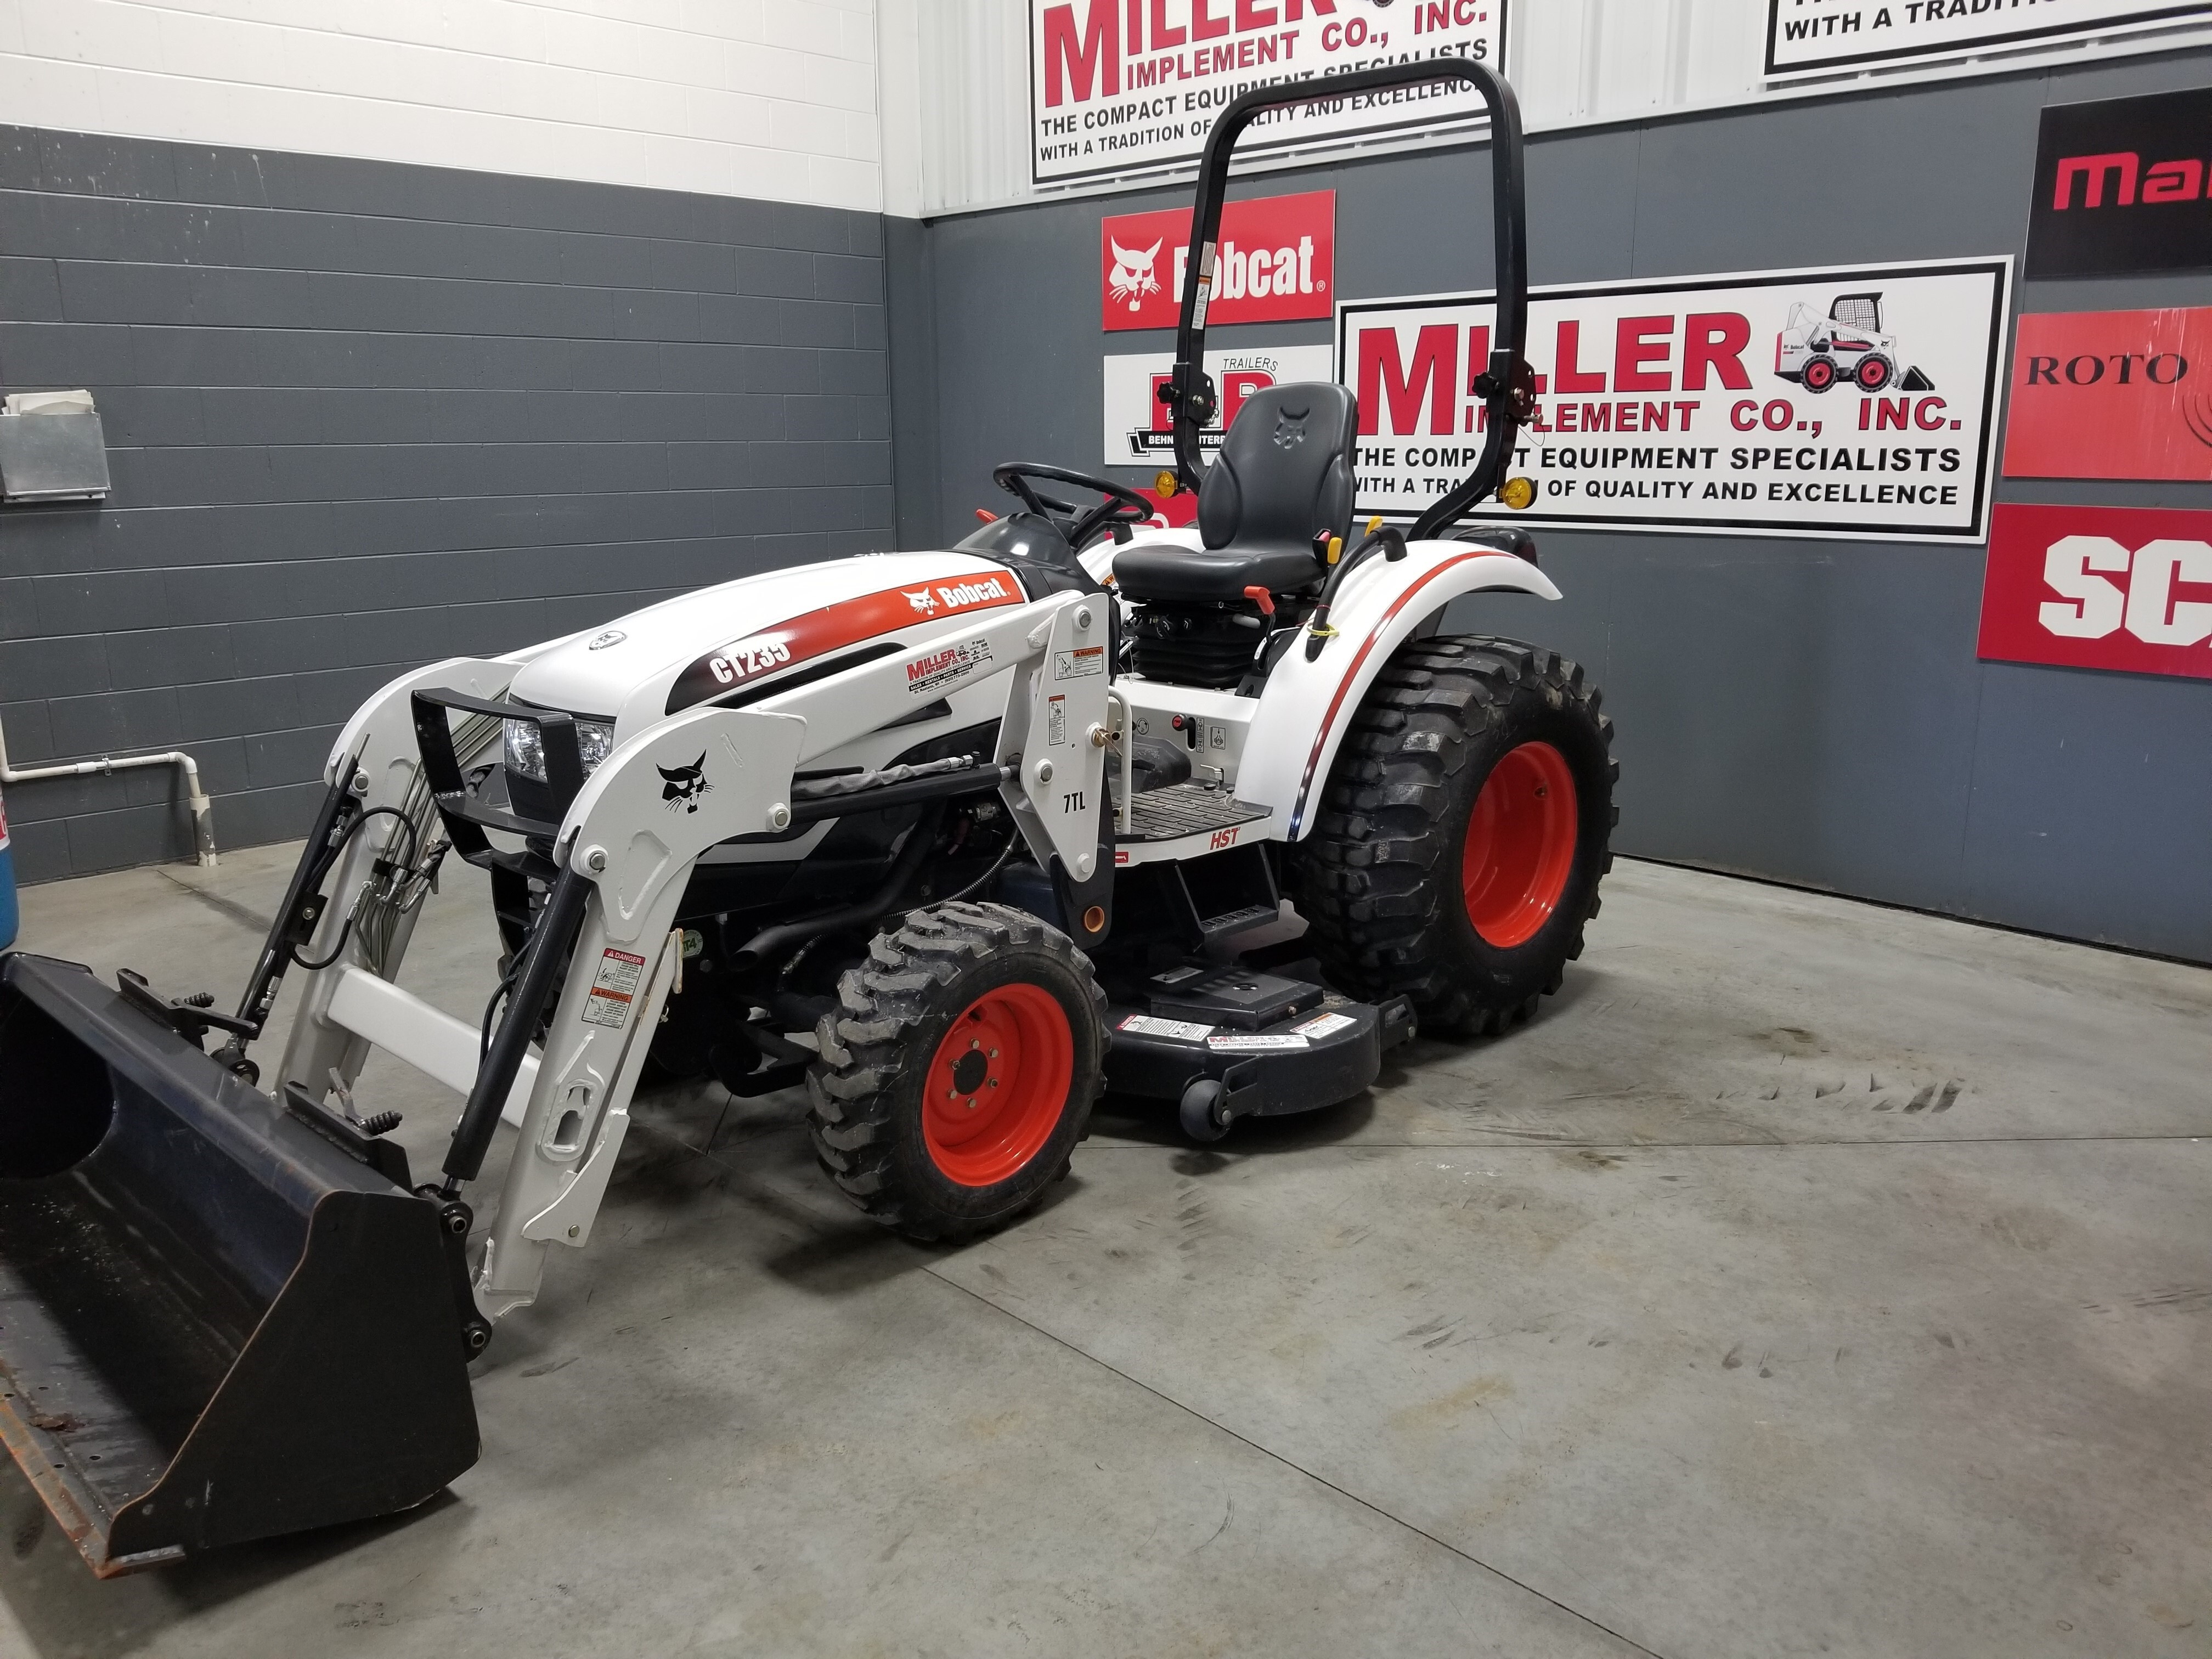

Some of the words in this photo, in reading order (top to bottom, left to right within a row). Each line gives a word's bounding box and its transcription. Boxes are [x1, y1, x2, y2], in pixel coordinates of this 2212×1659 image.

[1785, 12, 1861, 41] WITH
[1872, 8, 1892, 30] A
[1905, 0, 2057, 24] TRADI
[1044, 0, 1338, 108] MILL
[1128, 30, 1299, 91] IMPLEMENT
[1322, 17, 1389, 52] CO.,
[1414, 0, 1487, 35] INC.
[1040, 142, 1078, 161] WITH
[1084, 140, 1093, 155] A
[1099, 123, 1184, 152] TRADITION
[1190, 119, 1212, 136] OF
[1304, 100, 1344, 119] AND
[1352, 80, 1480, 111] EXCELLENC
[1041, 114, 1077, 137] THE
[1085, 95, 1177, 128] COMPACT
[2053, 151, 2212, 210] Ma
[1223, 357, 1278, 371] TRAILERS
[1358, 312, 1754, 436] MILER
[2024, 353, 2188, 385] ROTO
[1465, 400, 1701, 433] ILEMENT
[1730, 398, 1824, 439] CO.,
[1858, 396, 1962, 431] INC.
[1148, 435, 1174, 445] BEHN
[1353, 447, 1396, 467] THE
[1405, 447, 1531, 467] COMPT
[1541, 447, 1719, 470] EQUIPMENT
[1730, 447, 1961, 472] SPECIALISTS
[1402, 477, 1415, 494] A
[1548, 479, 1576, 496] OF
[1585, 479, 1694, 499] QUALITY
[1702, 482, 1757, 500] AND
[1767, 483, 1958, 505] EXCELLENCE
[936, 578, 1008, 608] Bobcat
[2039, 535, 2212, 648] SC
[709, 642, 791, 684] CT235
[906, 649, 956, 681] MILLER
[925, 676, 940, 685] RENTALS
[943, 670, 955, 679] PARTS
[957, 664, 972, 673] SERVICE
[926, 661, 951, 675] IMPLEMENT
[1063, 791, 1086, 814] 7TL
[1210, 827, 1240, 850] HST
[615, 952, 641, 964] DANGER
[601, 990, 628, 1001] WARNING
